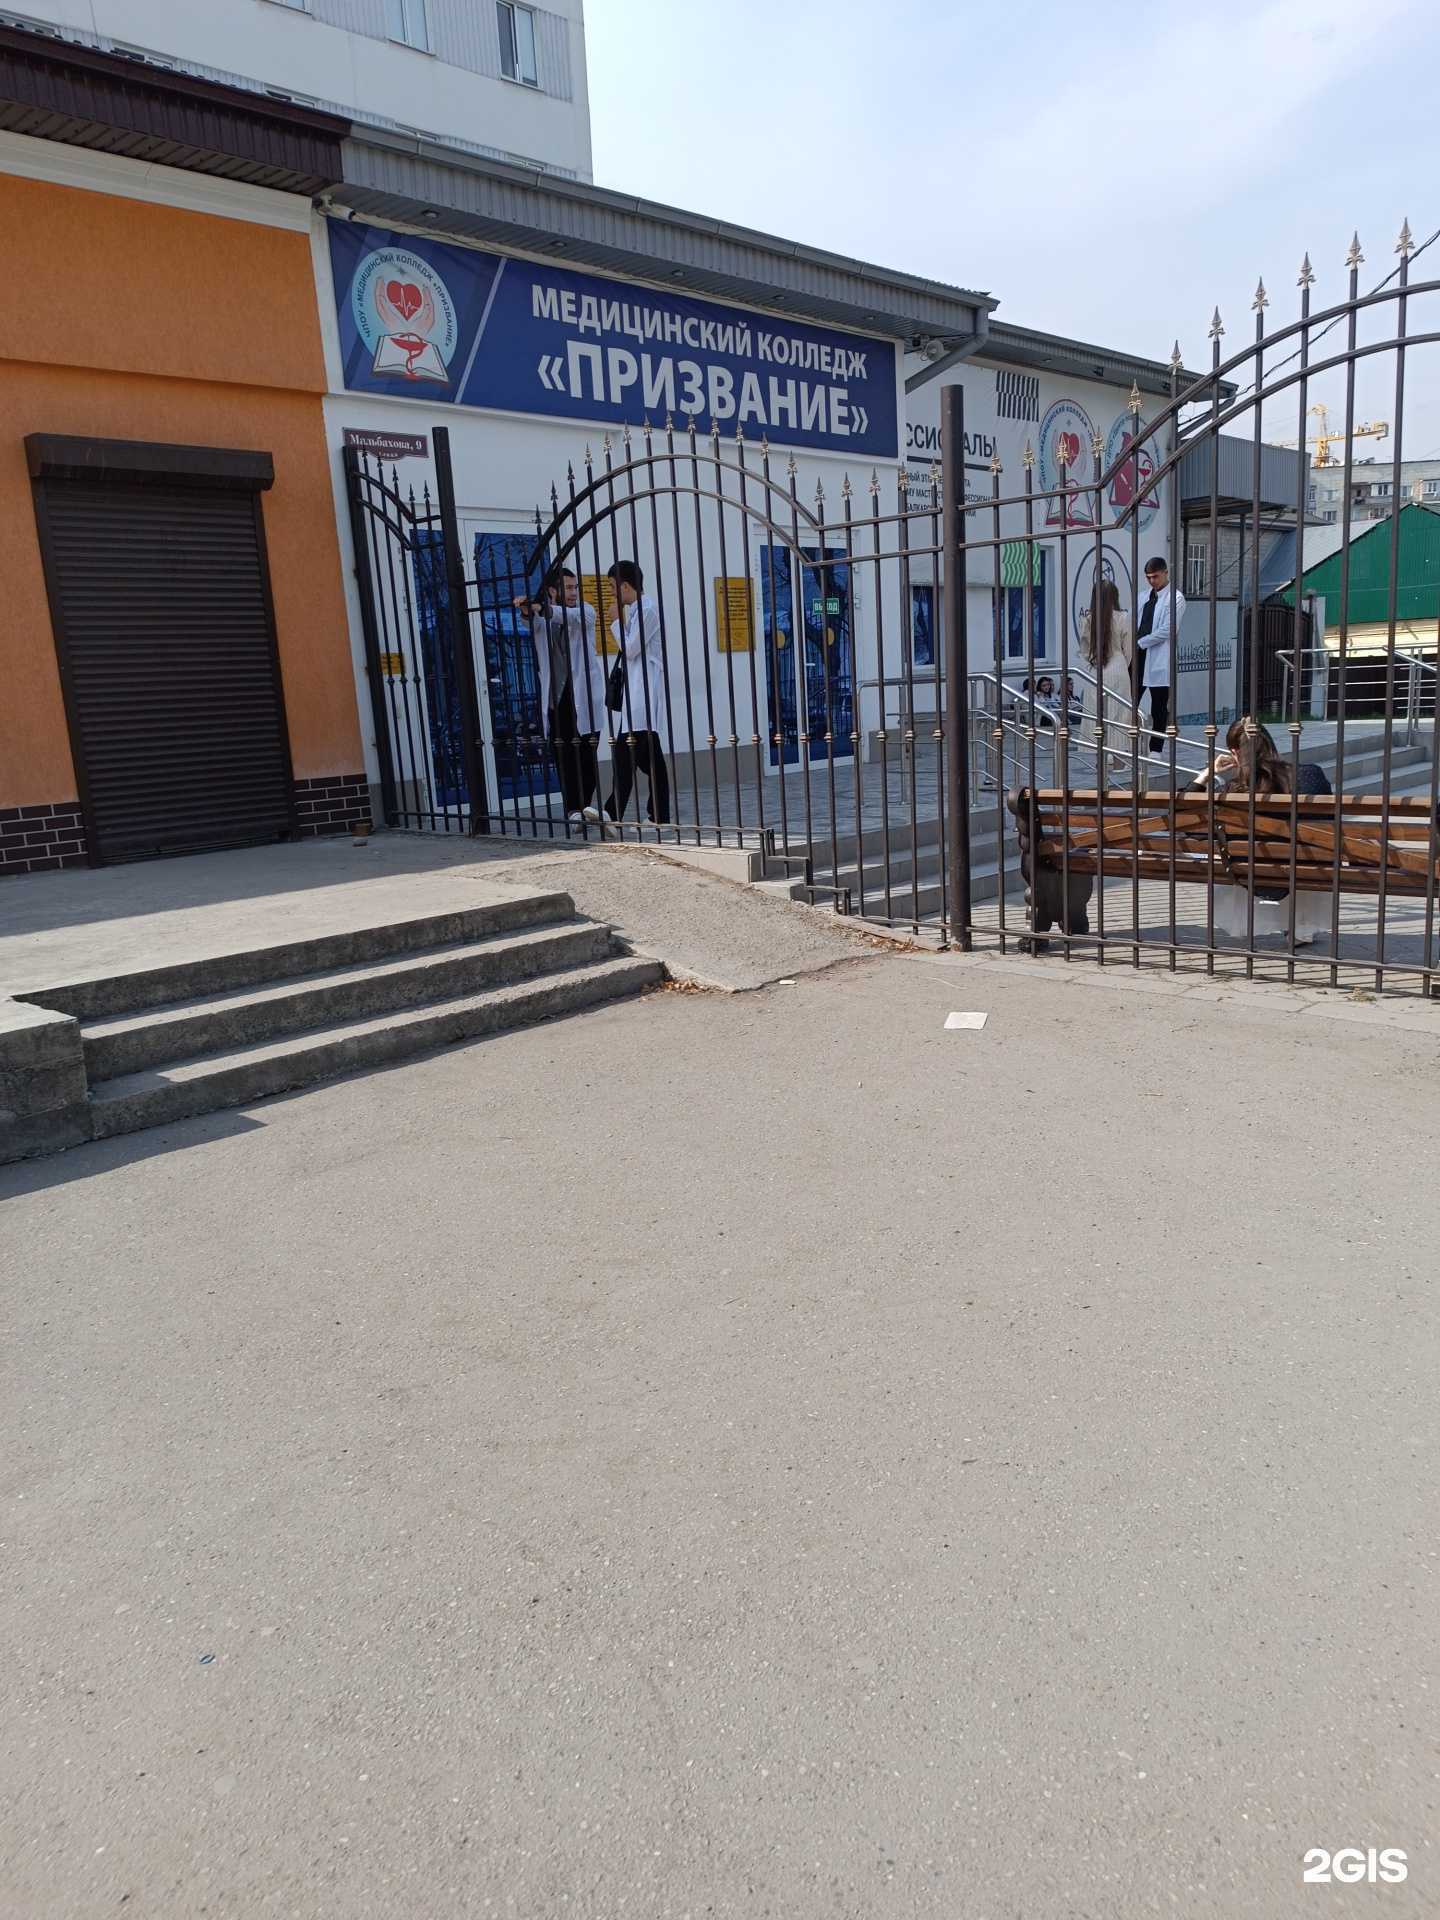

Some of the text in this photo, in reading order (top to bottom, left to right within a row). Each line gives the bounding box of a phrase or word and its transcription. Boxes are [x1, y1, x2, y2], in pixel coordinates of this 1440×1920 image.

[396, 254, 434, 282] КОЛЛЕДЖ
[532, 284, 868, 382] МЕДИЦИНСКИЙ КОЛЛЕДЖ
[537, 340, 869, 436] «ПРИЗВАНИЕ»
[350, 433, 422, 451] Мальбахова, 9
